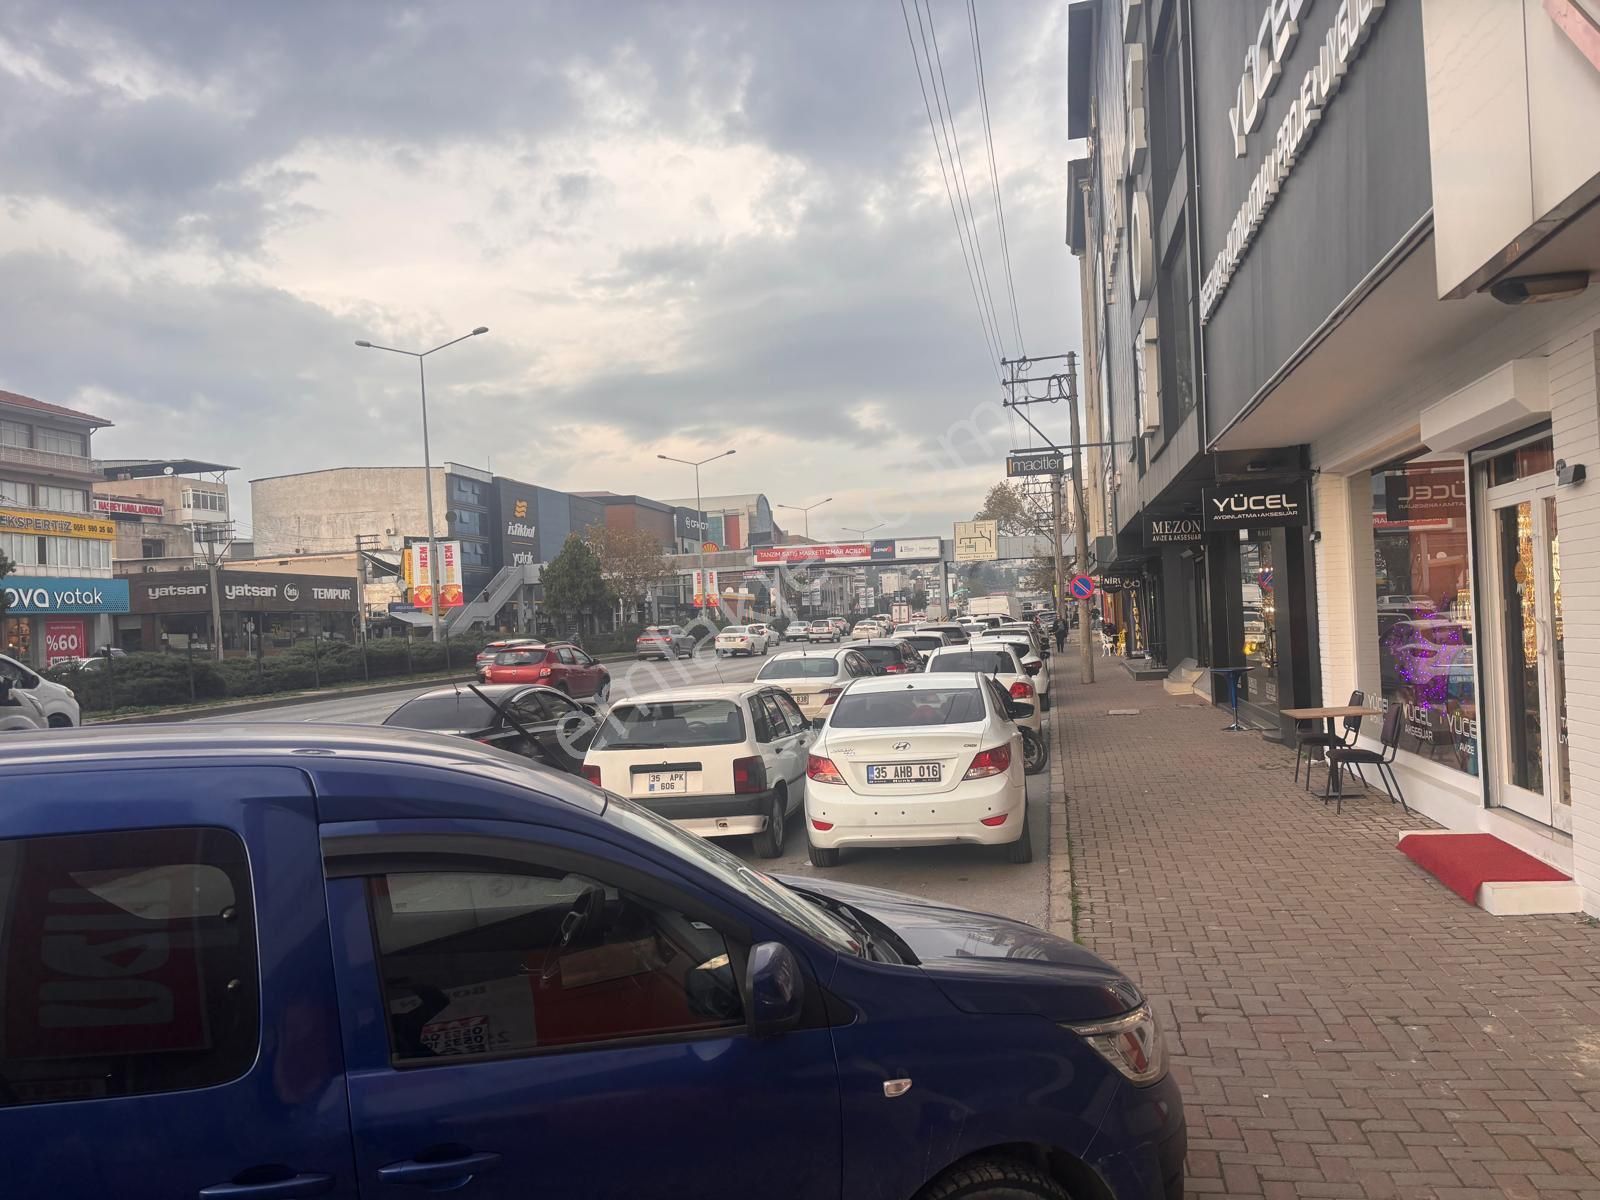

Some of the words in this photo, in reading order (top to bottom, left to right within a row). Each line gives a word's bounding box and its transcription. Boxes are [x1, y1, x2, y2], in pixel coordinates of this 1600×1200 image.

[1212, 493, 1298, 512] YÜCEL
[1213, 512, 1257, 520] AYDINLATMA
[1260, 510, 1298, 518] AKSESUAR
[1152, 519, 1201, 535] MEZON
[54, 586, 103, 609] yatak
[148, 584, 208, 599] yatsan
[225, 583, 277, 600] yatsan
[312, 587, 351, 600] TEMPUR
[46, 634, 79, 651] %60
[1403, 700, 1433, 727] YÜCEL
[650, 774, 661, 783] 35
[669, 773, 684, 782] APK
[875, 766, 887, 779] 35
[894, 765, 913, 779] AHB
[918, 765, 938, 778] 016
[660, 782, 675, 791] 606
